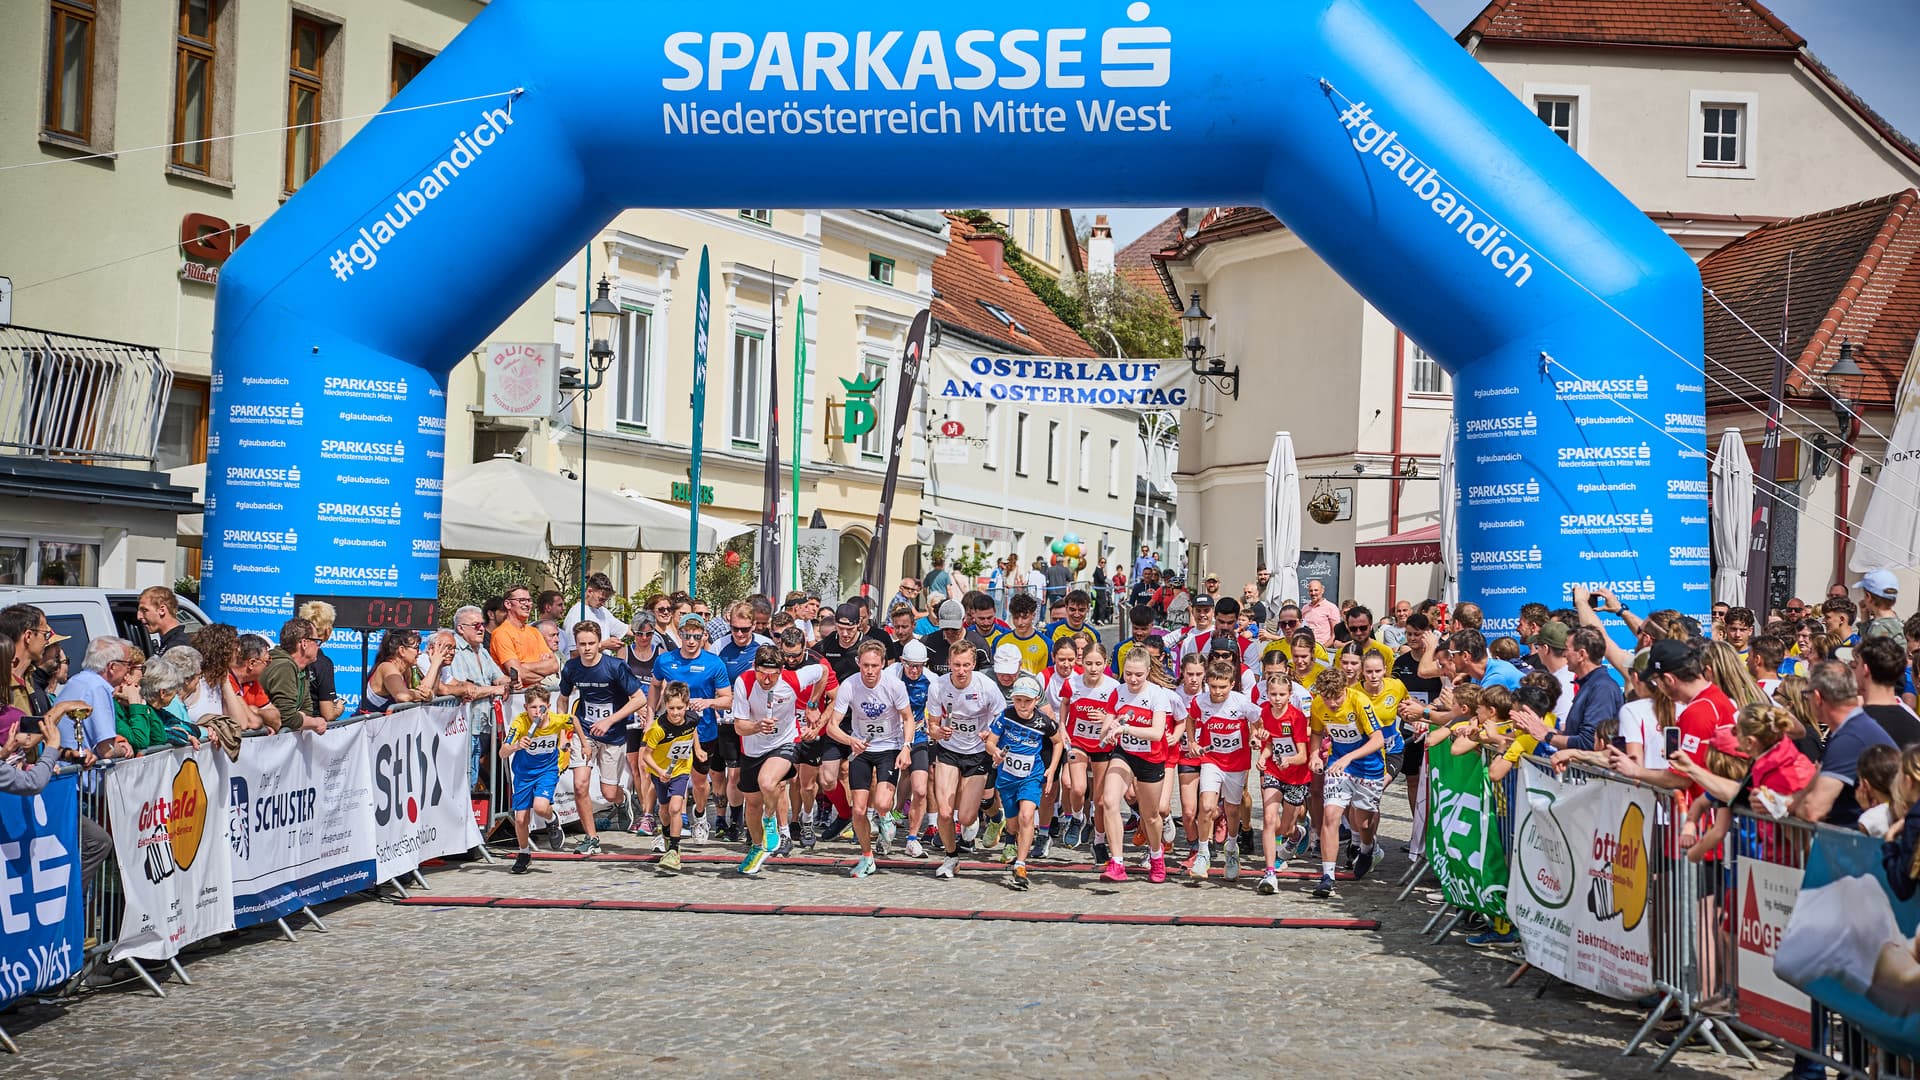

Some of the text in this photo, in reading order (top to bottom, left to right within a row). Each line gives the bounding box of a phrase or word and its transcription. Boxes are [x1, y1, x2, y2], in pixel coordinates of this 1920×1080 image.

[662, 28, 1087, 91] SPARKASSE
[662, 99, 1171, 135] Niederösterreich Mitte West
[329, 107, 514, 282] #glaubandich
[1338, 101, 1533, 288] #glaubandich
[493, 345, 545, 367] QUICK
[970, 356, 1161, 382] OSTERLAUF
[242, 376, 288, 386] #glaubandich
[324, 377, 396, 392] SPARKASSE
[1556, 379, 1634, 393] SPARKASSE
[393, 393, 406, 401] West
[941, 379, 1188, 406] AM OSTERMONTAG
[1474, 386, 1520, 398] #glaubandich
[1632, 391, 1648, 400] West
[230, 404, 289, 418] SPARKASSE
[340, 411, 392, 423] #glaubandich
[1466, 417, 1522, 432] SPARKASSE
[1574, 415, 1634, 426] #glaubandich
[239, 439, 286, 448] #glaubandich
[321, 440, 392, 455] SPARKASSE
[1476, 452, 1522, 464] #glaubandich
[1558, 446, 1636, 460] SPARKASSE
[391, 456, 404, 464] West
[1634, 458, 1651, 467] West
[226, 468, 286, 480] SPARKASSE
[336, 474, 390, 486] #glaubandich
[1468, 483, 1524, 498] SPARKASSE
[1577, 482, 1636, 493] #glaubandich
[236, 502, 283, 511] #glaubandich
[318, 502, 390, 518] SPARKASSE
[387, 518, 400, 526] West
[1479, 519, 1524, 530] #glaubandich
[1560, 513, 1639, 528] SPARKASSE
[1636, 525, 1653, 534] West
[224, 530, 283, 542] SPARKASSE
[333, 536, 386, 548] #glaubandich
[1470, 550, 1526, 564] SPARKASSE
[1579, 549, 1638, 560] #glaubandich
[232, 564, 280, 574] #glaubandich
[314, 565, 386, 580] SPARKASSE
[384, 580, 398, 588] West
[1481, 586, 1527, 596] #glaubandich
[220, 592, 280, 606] SPARKASSE
[587, 706, 610, 718] 51a
[866, 724, 884, 733] 2a
[1330, 728, 1358, 738] 90a
[1122, 733, 1148, 746] 58a
[1212, 737, 1240, 748] 92a
[1006, 757, 1031, 771] 60a
[254, 787, 316, 833] SCHUSTER
[28, 937, 72, 992] West
